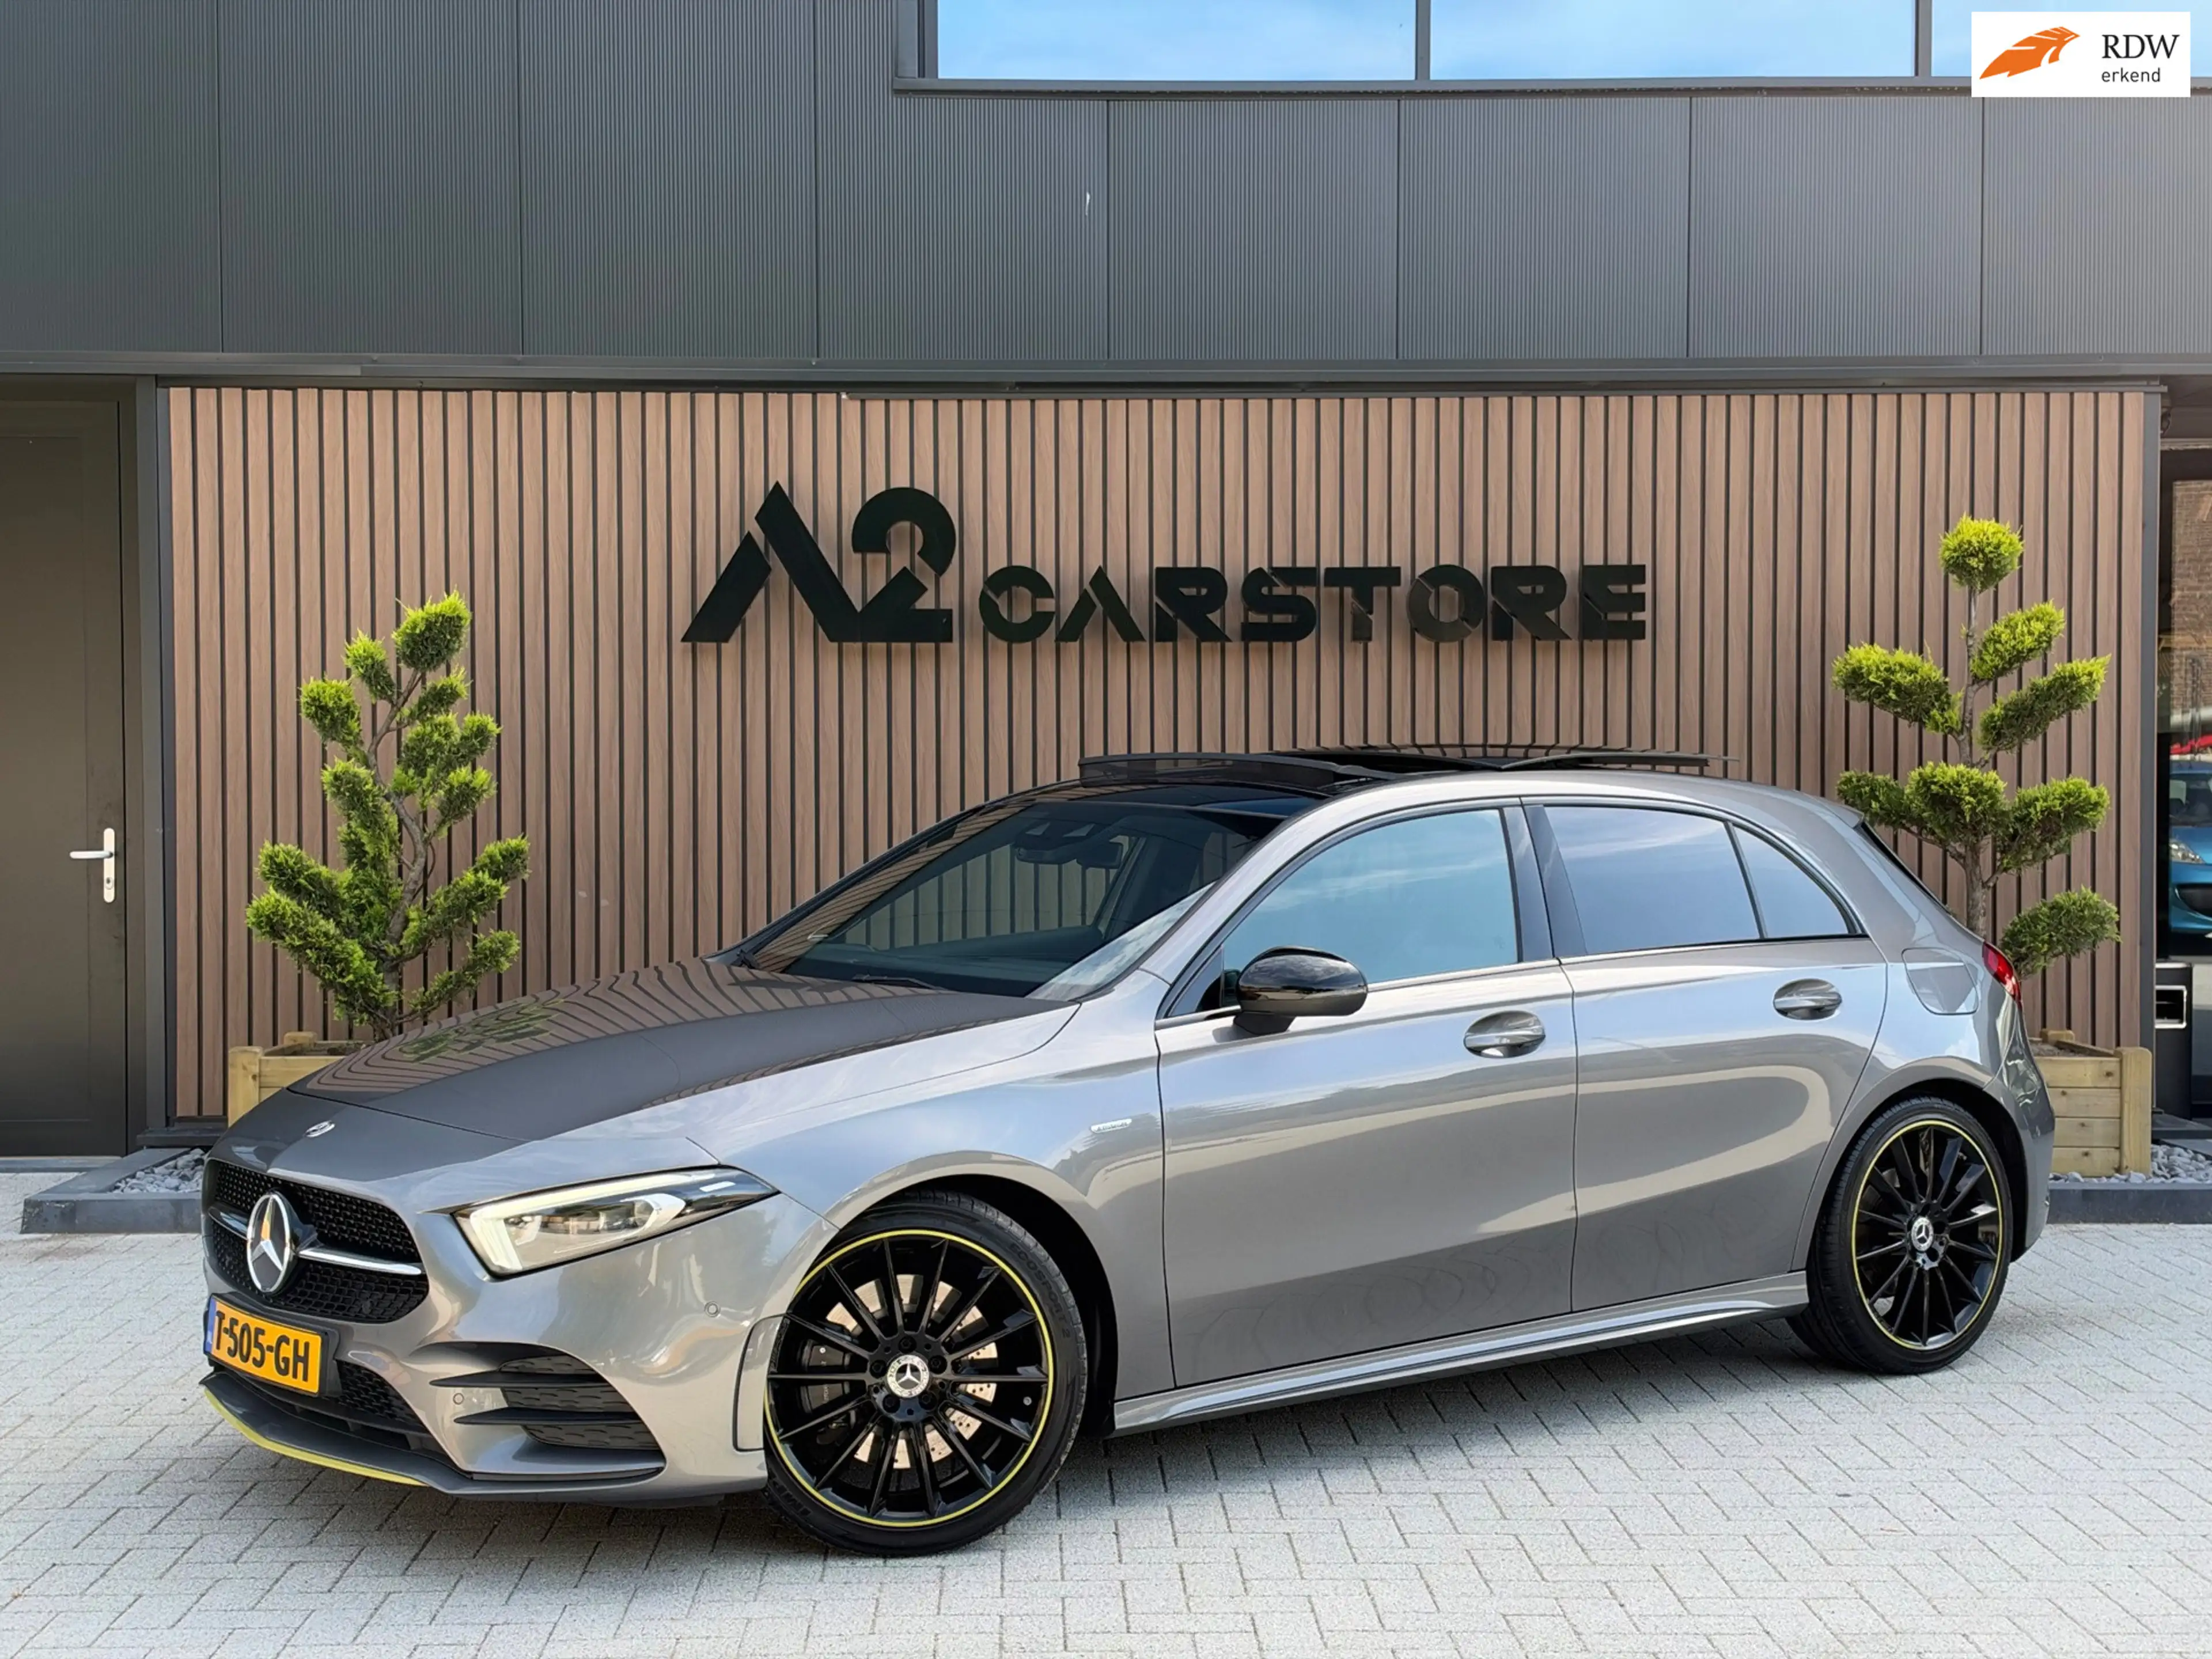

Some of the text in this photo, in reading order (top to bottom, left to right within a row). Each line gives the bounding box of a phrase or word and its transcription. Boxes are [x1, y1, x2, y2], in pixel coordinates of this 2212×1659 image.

[681, 480, 1646, 643] A2 CARSTORE
[215, 1309, 310, 1382] T-505-GH
